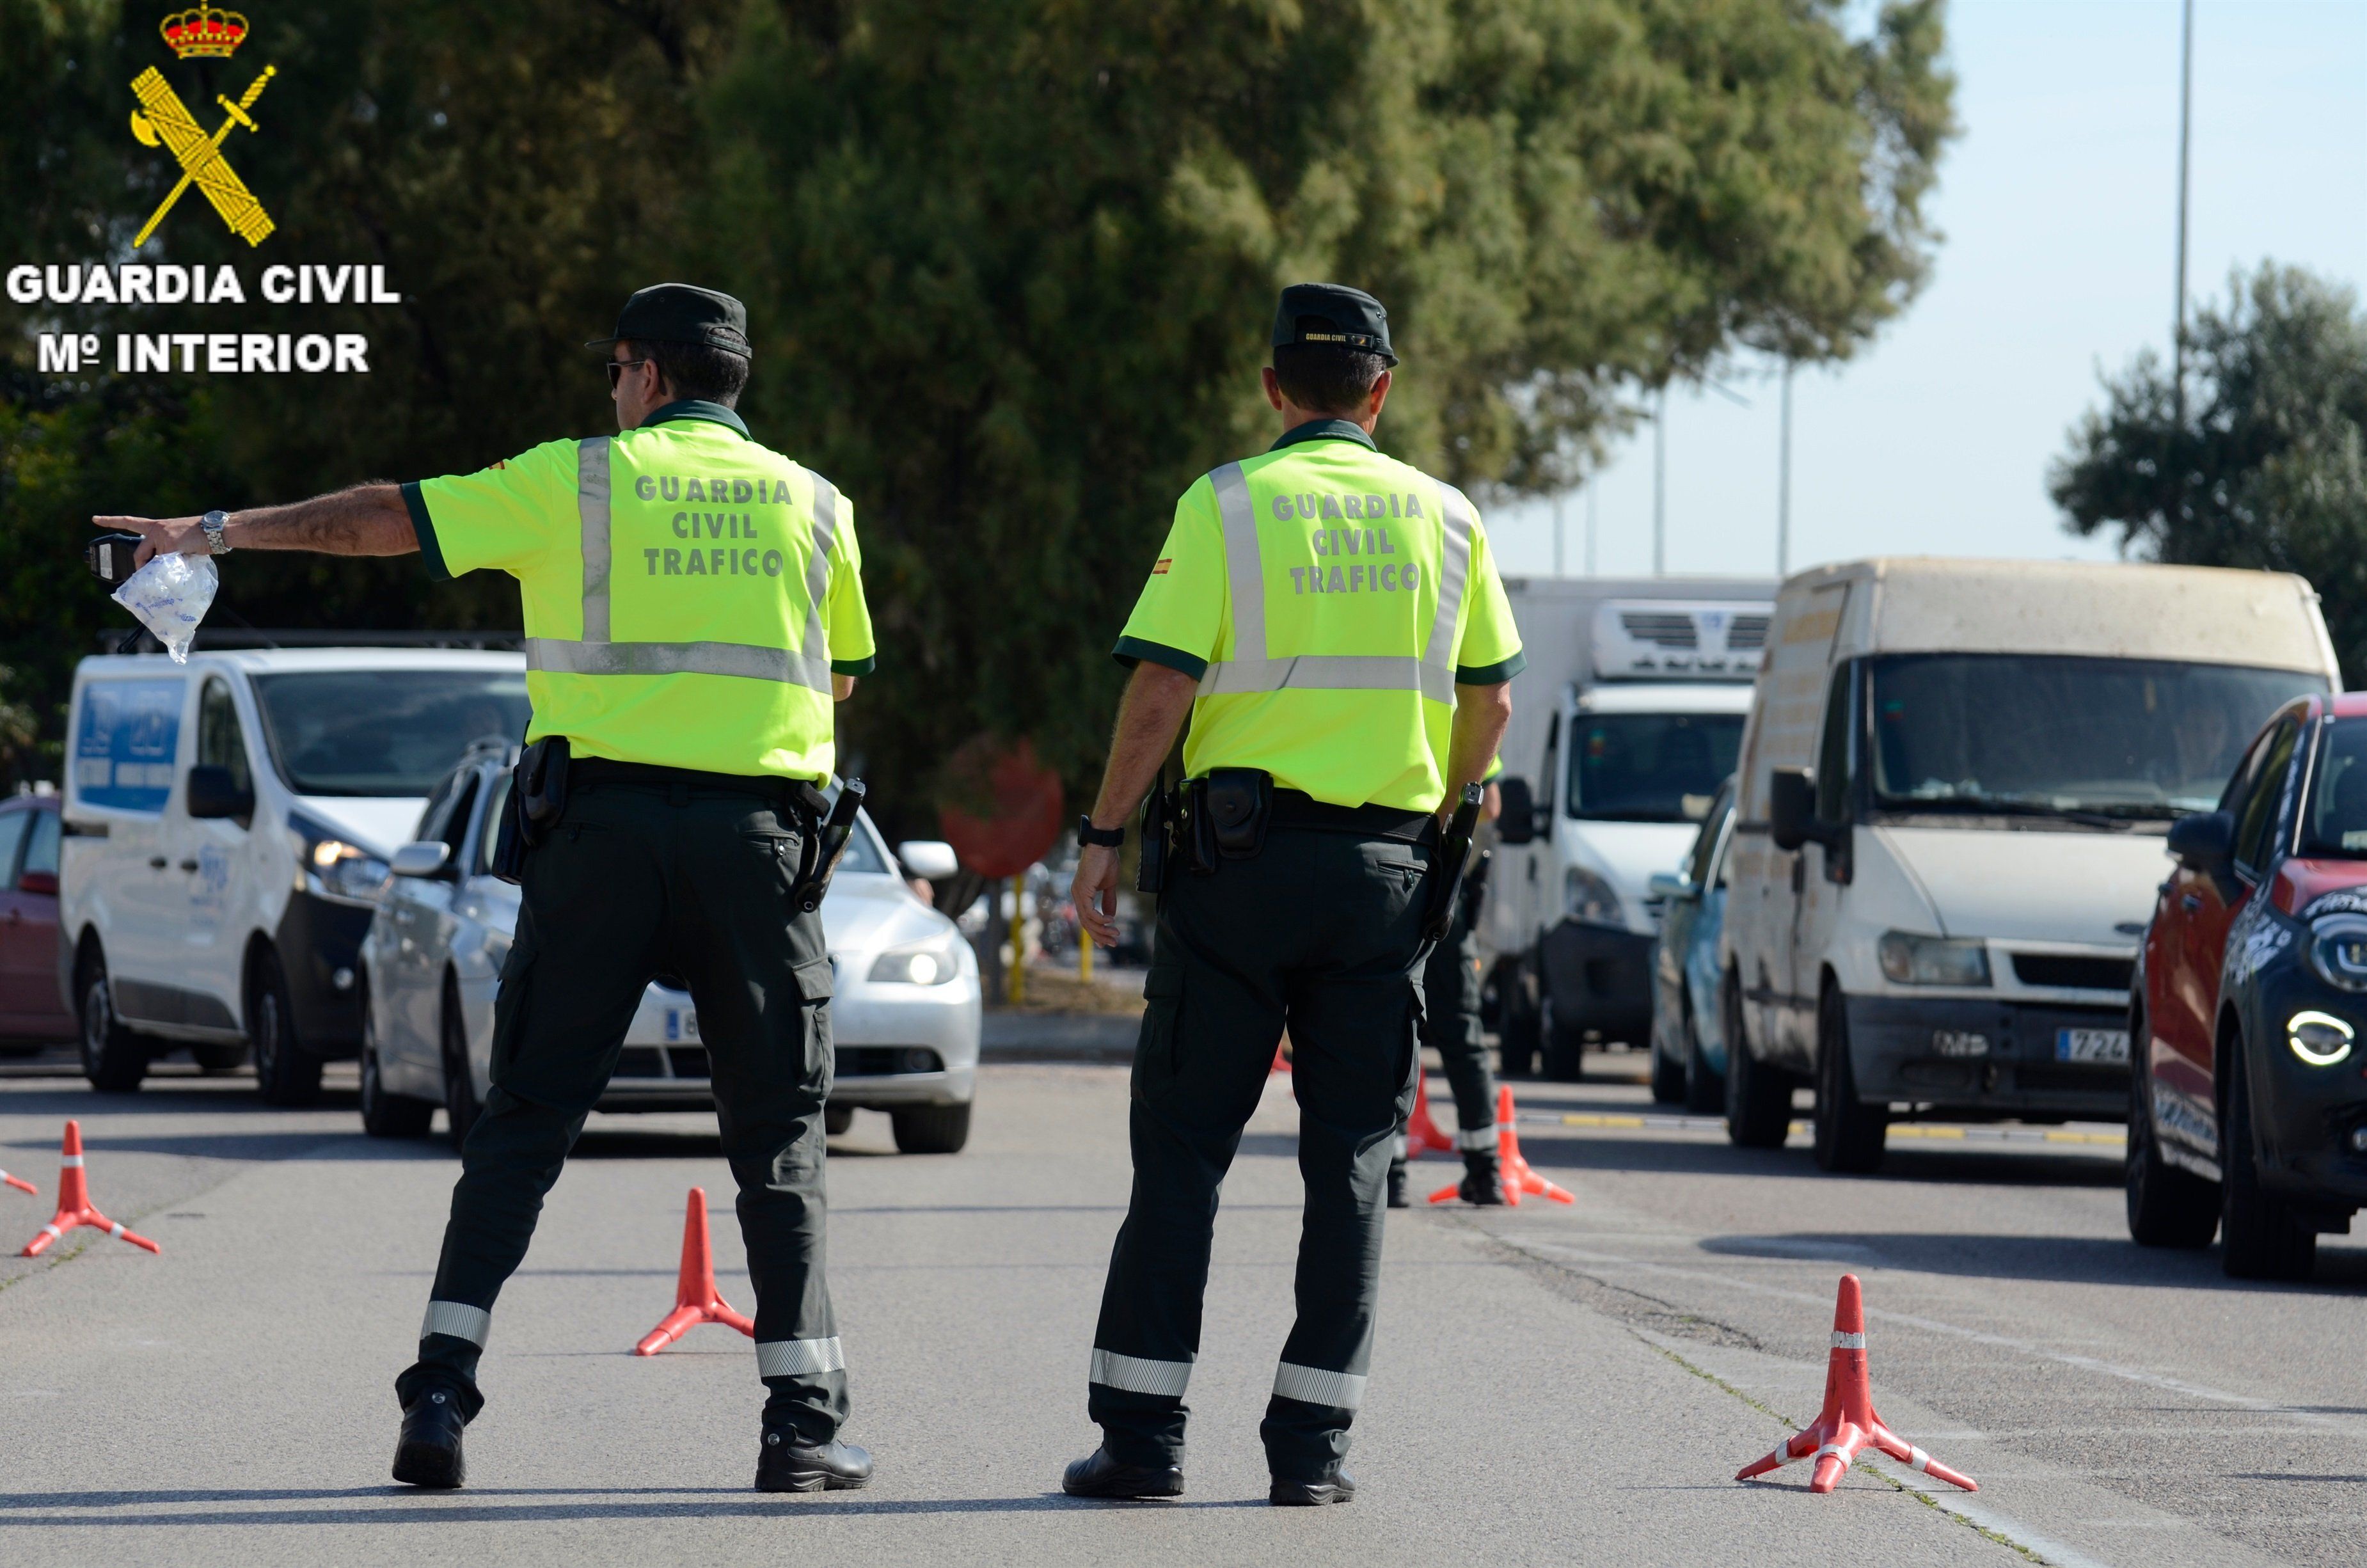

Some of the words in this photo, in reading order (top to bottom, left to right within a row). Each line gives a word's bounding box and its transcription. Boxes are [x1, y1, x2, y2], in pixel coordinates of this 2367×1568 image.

[1306, 333, 1331, 341] GUARDIA
[1331, 334, 1346, 342] CIVIL
[635, 475, 793, 505] GUARDIA
[1272, 493, 1424, 521] GUARDIA
[672, 512, 757, 539] CIVIL
[1313, 528, 1395, 556] CIVIL
[644, 548, 783, 577] TRAFICO
[1290, 563, 1420, 594] TRAFICO
